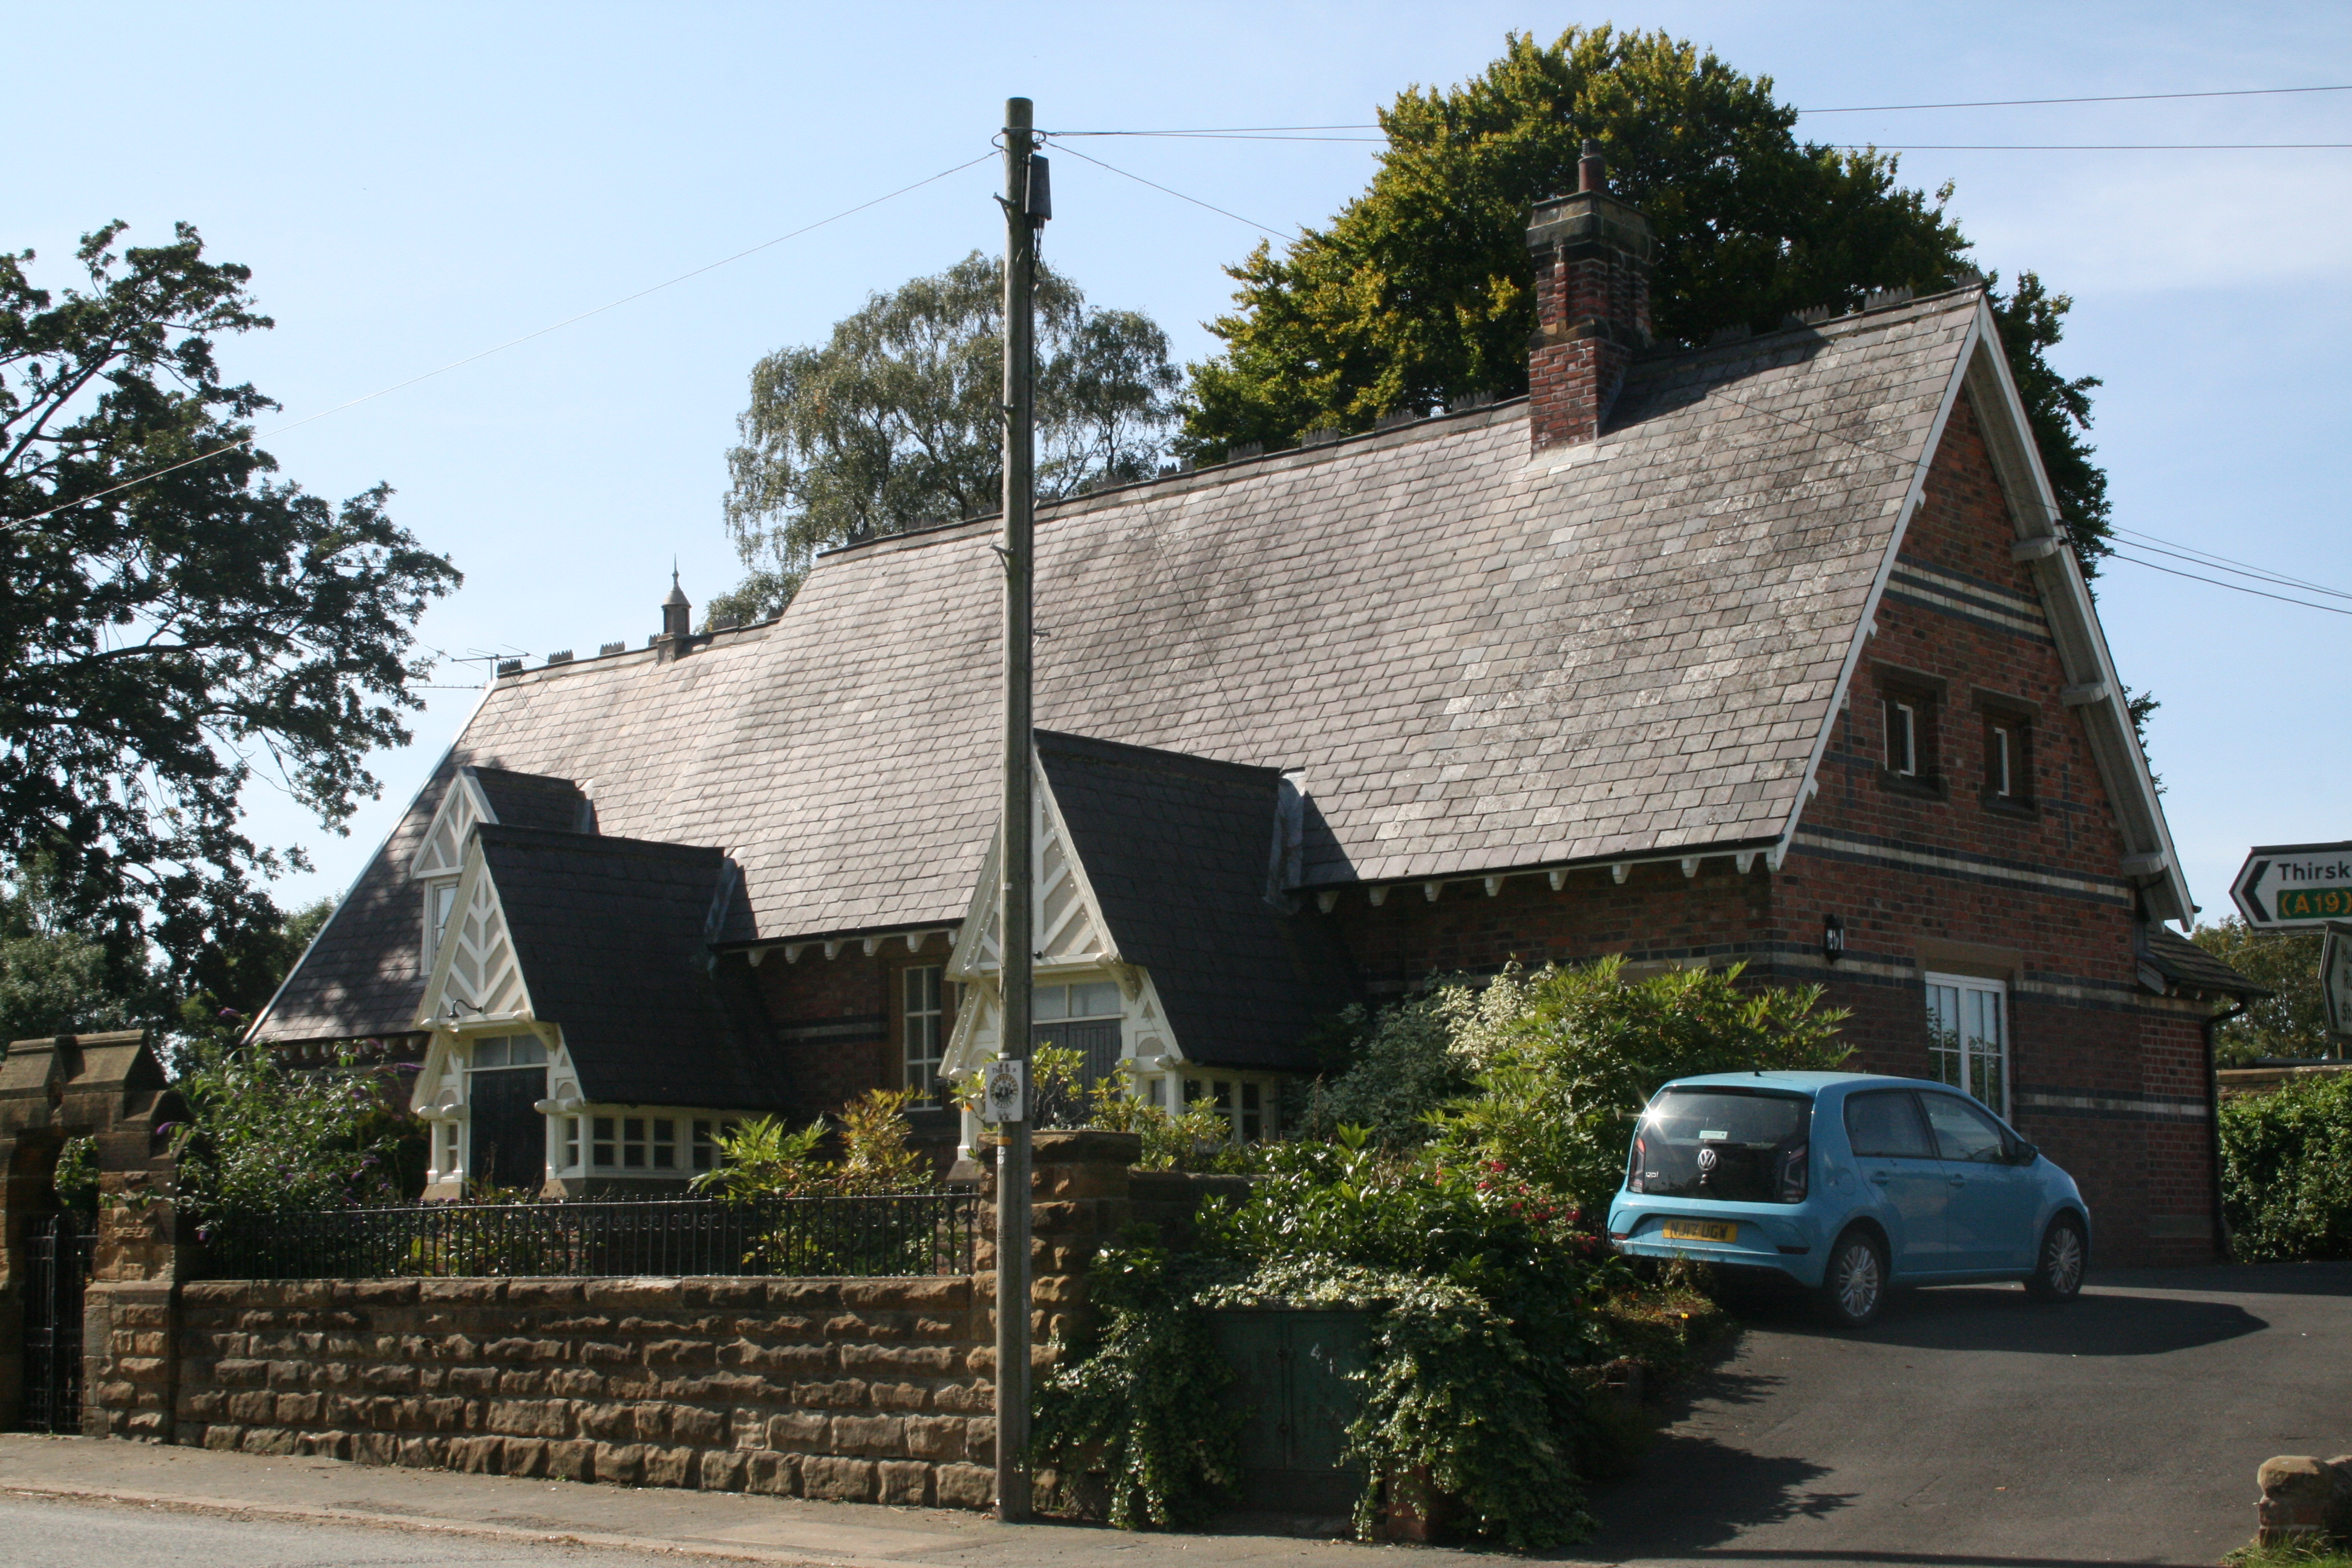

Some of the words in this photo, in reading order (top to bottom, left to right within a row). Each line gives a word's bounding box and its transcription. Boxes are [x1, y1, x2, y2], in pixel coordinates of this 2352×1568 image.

[2277, 861, 2351, 881] Thirsk
[2281, 890, 2352, 916] (A19)
[1671, 1221, 1699, 1238] NJ17
[1700, 1223, 1728, 1240] UGW
